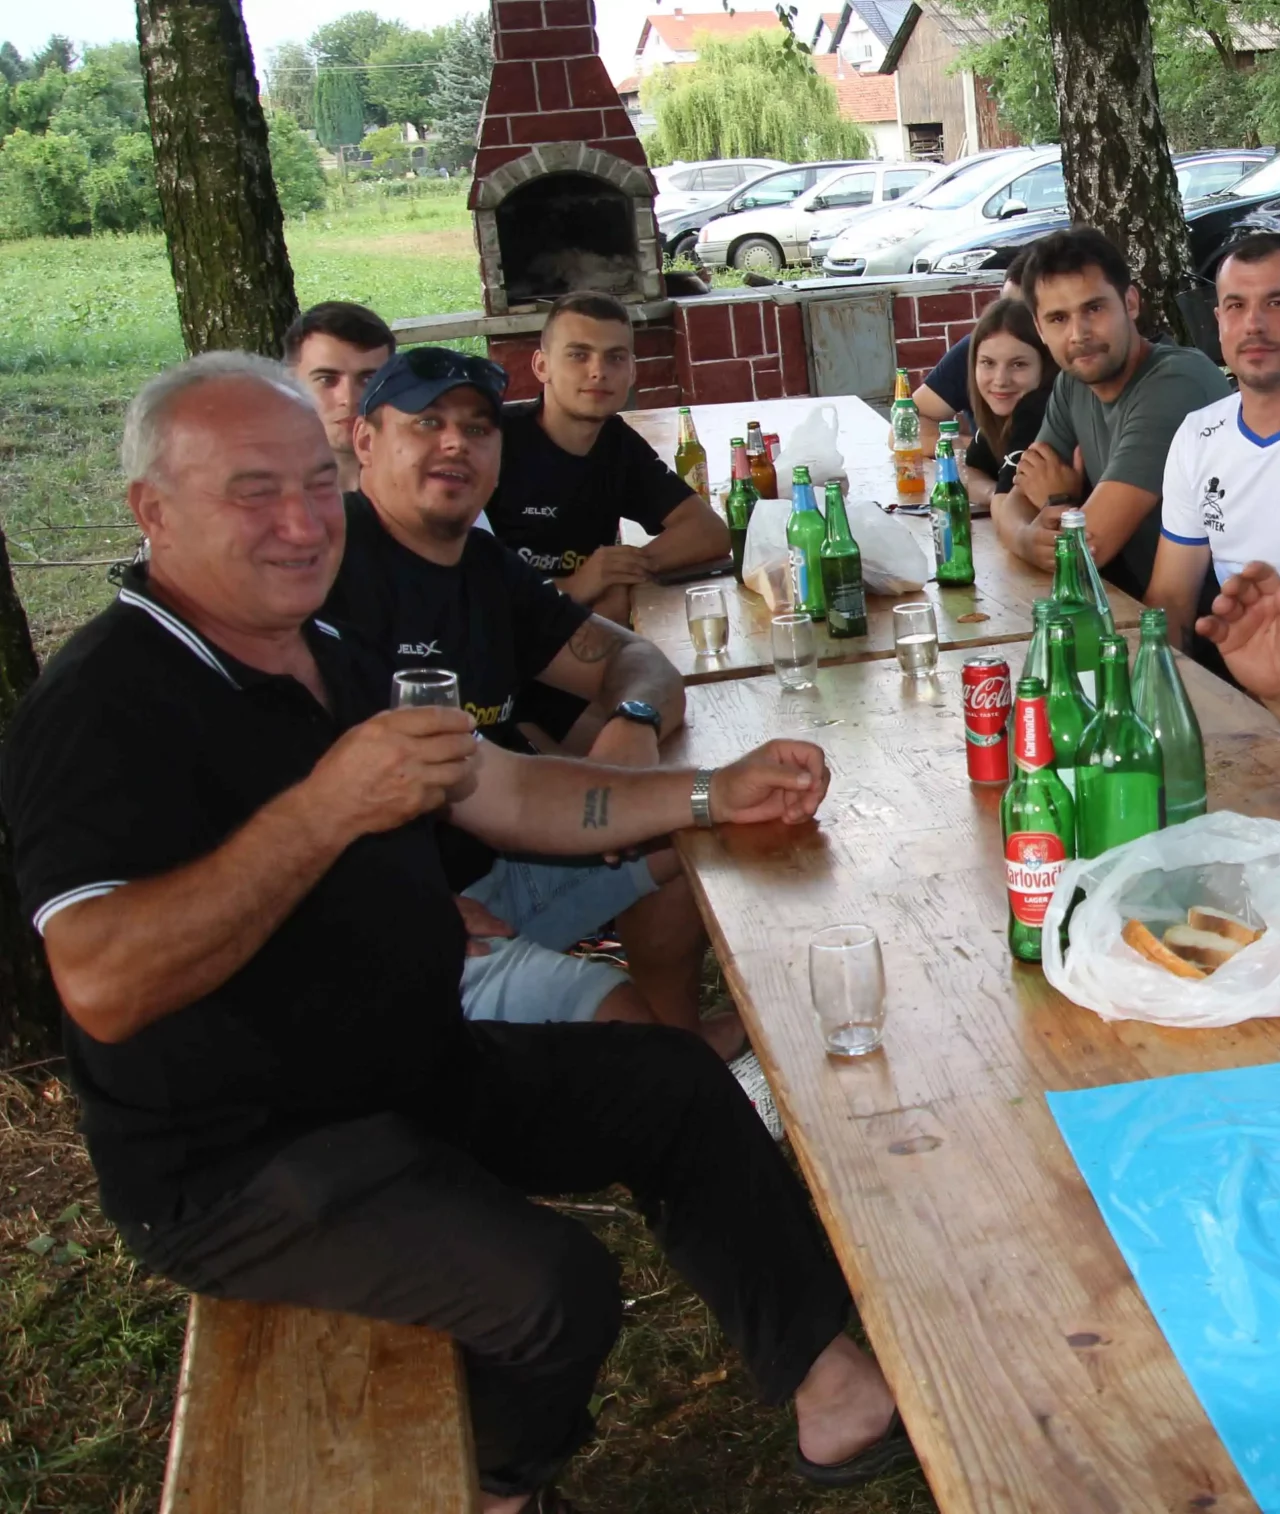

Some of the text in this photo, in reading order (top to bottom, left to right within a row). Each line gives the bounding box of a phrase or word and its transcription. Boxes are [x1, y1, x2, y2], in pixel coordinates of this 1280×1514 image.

[521, 506, 558, 518] JELEX
[397, 639, 442, 657] JELEX
[1023, 896, 1049, 904] LAGER
